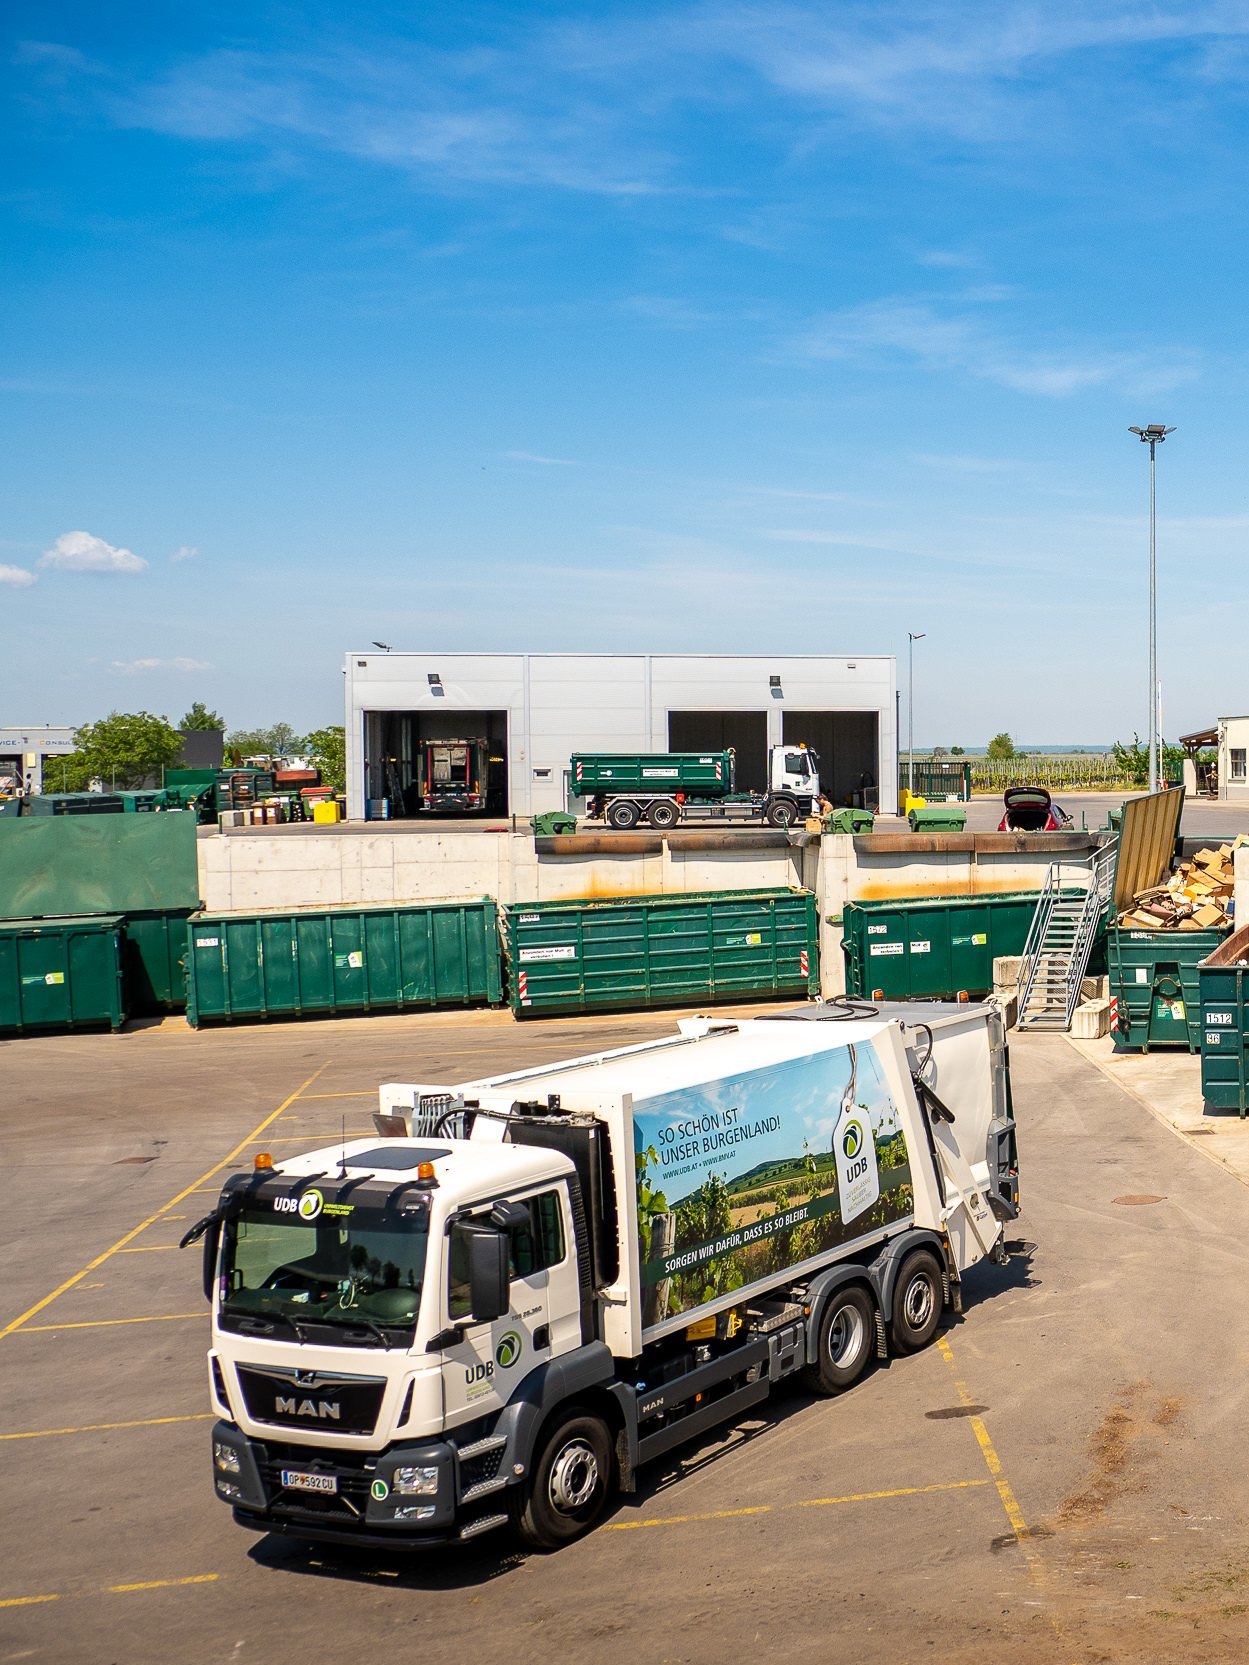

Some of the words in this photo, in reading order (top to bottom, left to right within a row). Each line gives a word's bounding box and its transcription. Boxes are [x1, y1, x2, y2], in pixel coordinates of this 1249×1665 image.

[1208, 1013, 1231, 1023] 1512
[658, 1127, 674, 1146] SO
[678, 1114, 719, 1140] SCHÖN
[722, 1108, 738, 1126] IST
[661, 1140, 700, 1166] UNSER
[702, 1115, 780, 1153] BURGENLAND!
[662, 1162, 698, 1180] WWW.UDB.AT
[846, 1156, 868, 1183] UDB
[274, 1197, 298, 1212] UDB
[665, 1250, 697, 1273] SORGEN
[698, 1244, 714, 1260] WIR
[715, 1234, 742, 1253] DAFÜR,
[744, 1225, 763, 1241] DASS
[764, 1221, 773, 1233] ES
[774, 1217, 784, 1230] SO
[785, 1207, 809, 1225] BLEIBT.
[465, 1361, 494, 1384] UDB
[275, 1396, 340, 1419] MAN
[642, 1397, 664, 1413] MAN
[289, 1474, 300, 1484] OP
[306, 1476, 320, 1488] 592
[322, 1478, 333, 1489] CU
[375, 1484, 384, 1497] L
